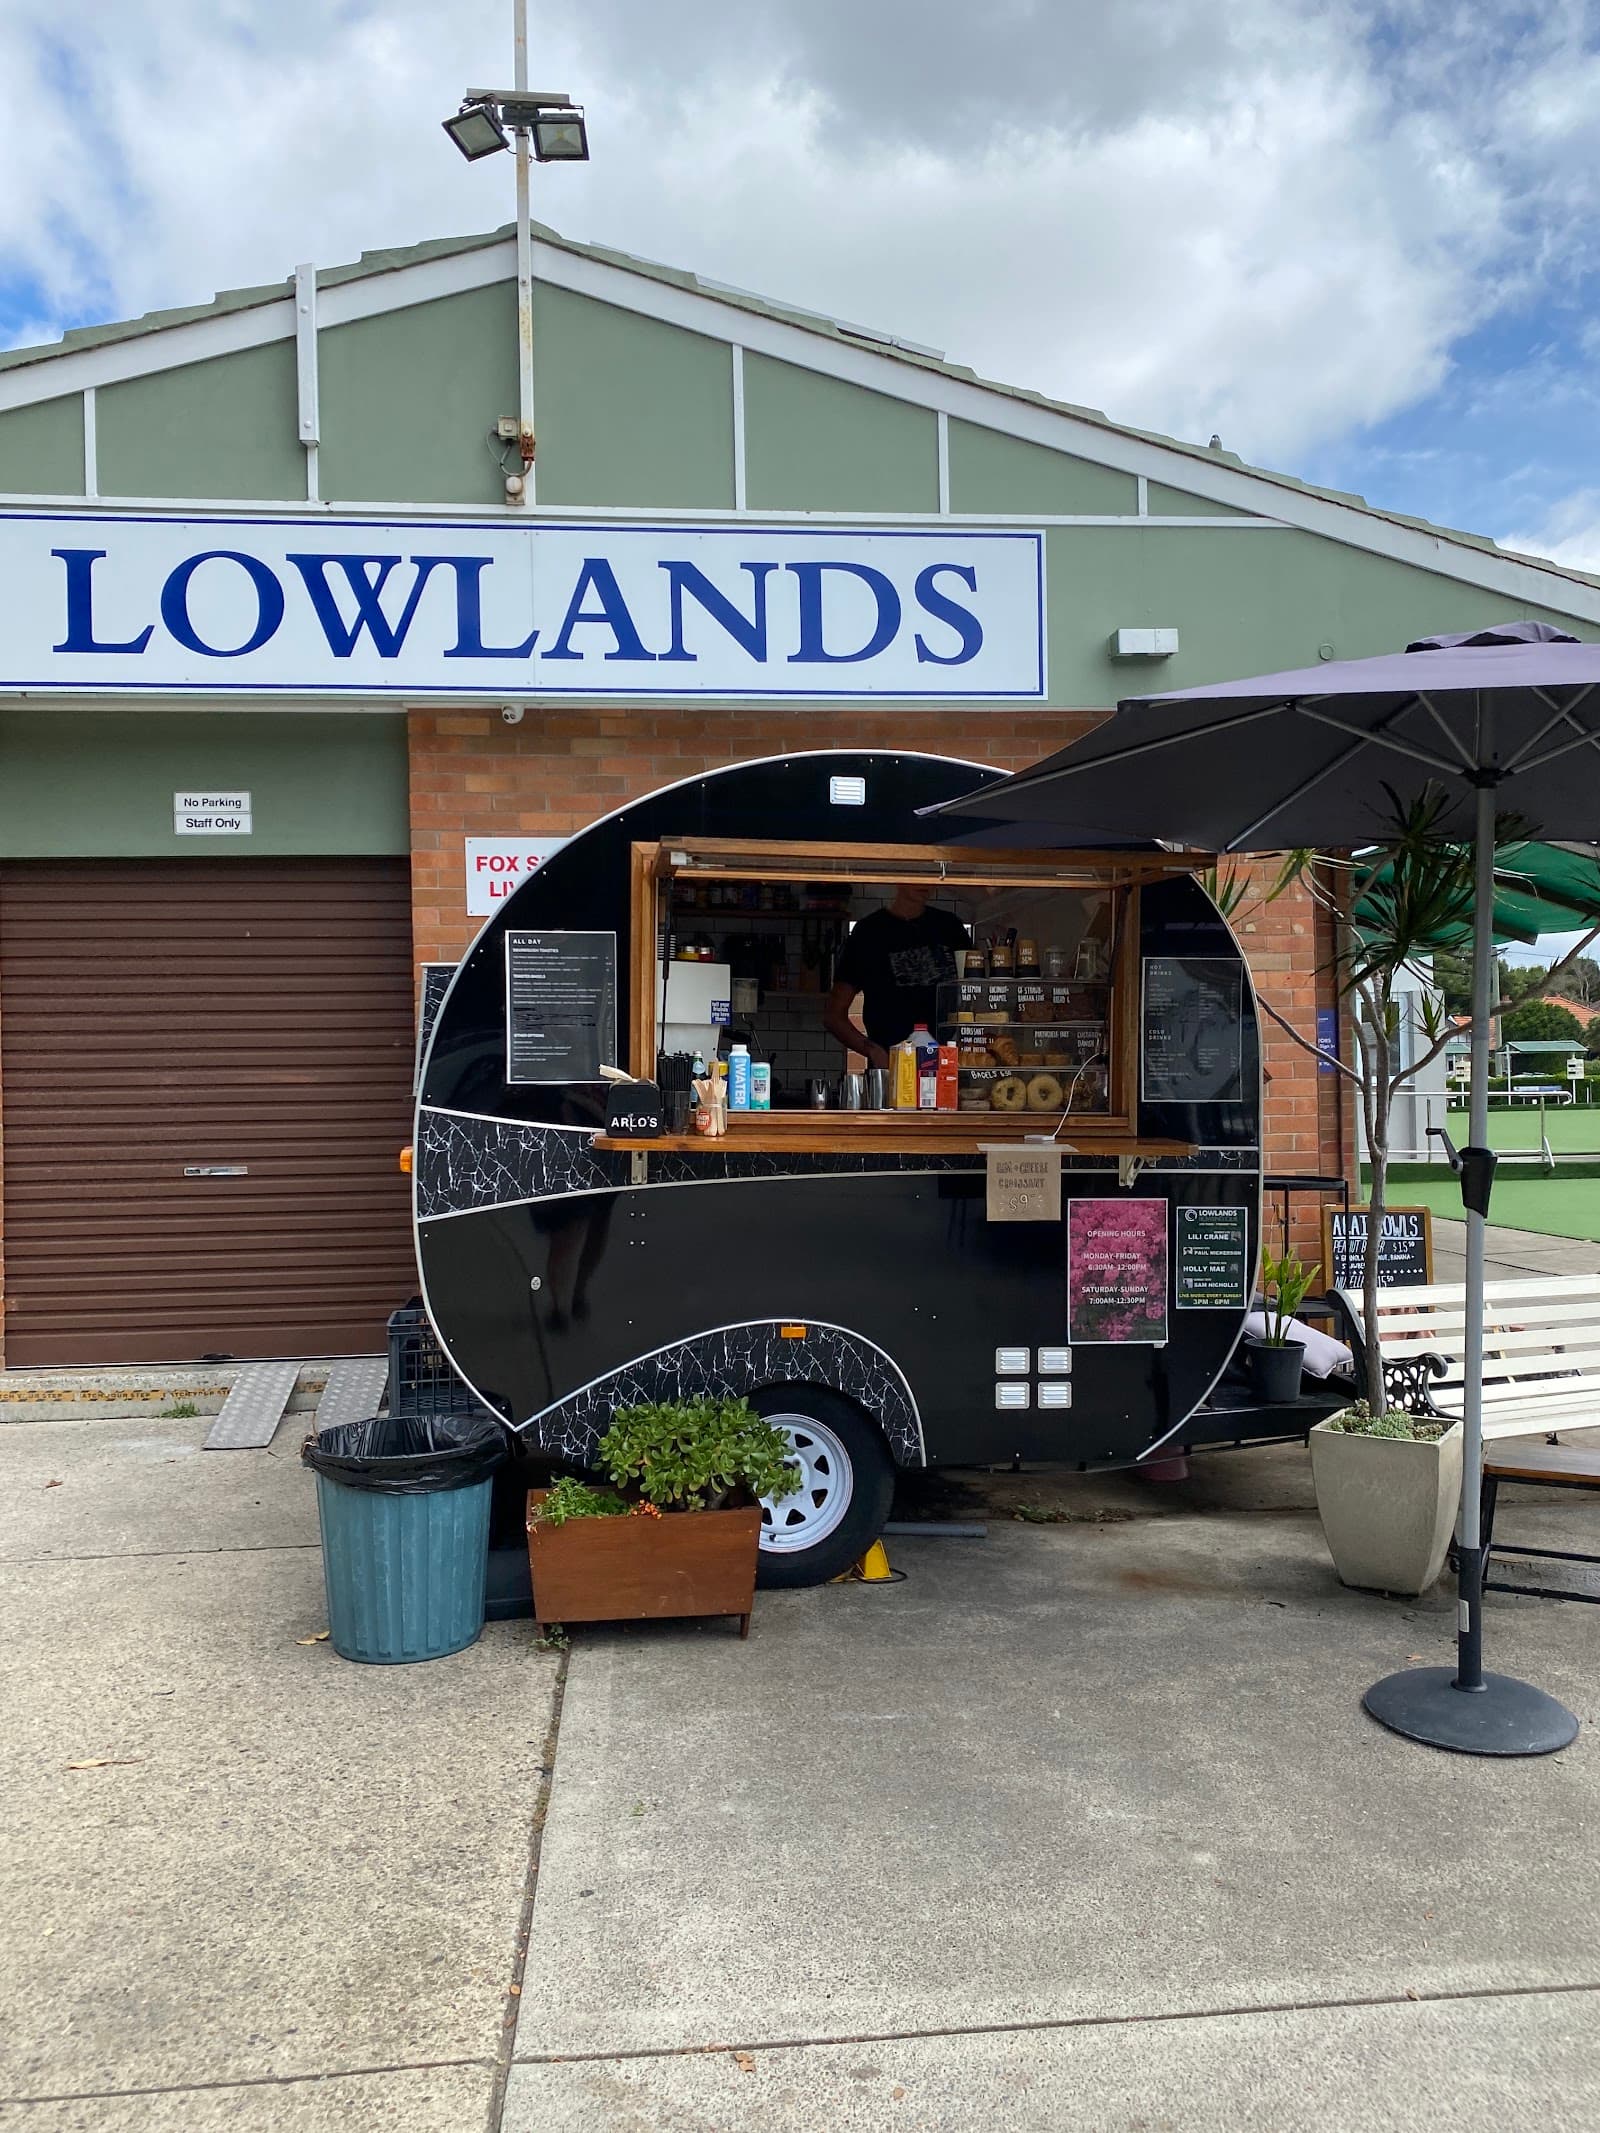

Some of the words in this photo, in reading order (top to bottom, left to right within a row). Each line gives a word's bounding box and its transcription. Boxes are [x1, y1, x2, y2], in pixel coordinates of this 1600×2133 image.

[51, 549, 983, 665] LOWLANDS
[184, 798, 199, 807] No
[202, 798, 242, 809] Parking
[186, 818, 213, 828] Staff
[215, 818, 241, 830] Only
[476, 855, 520, 872] FOX
[611, 1114, 658, 1131] ARLO'S
[1199, 1209, 1238, 1217] LOWLANDS
[1380, 1214, 1418, 1238] OWLS
[1087, 1230, 1120, 1238] OPENING
[1083, 1252, 1141, 1260] MONDAY-FRIDAY
[1081, 1286, 1149, 1294] SATURDAY-SUNDAY
